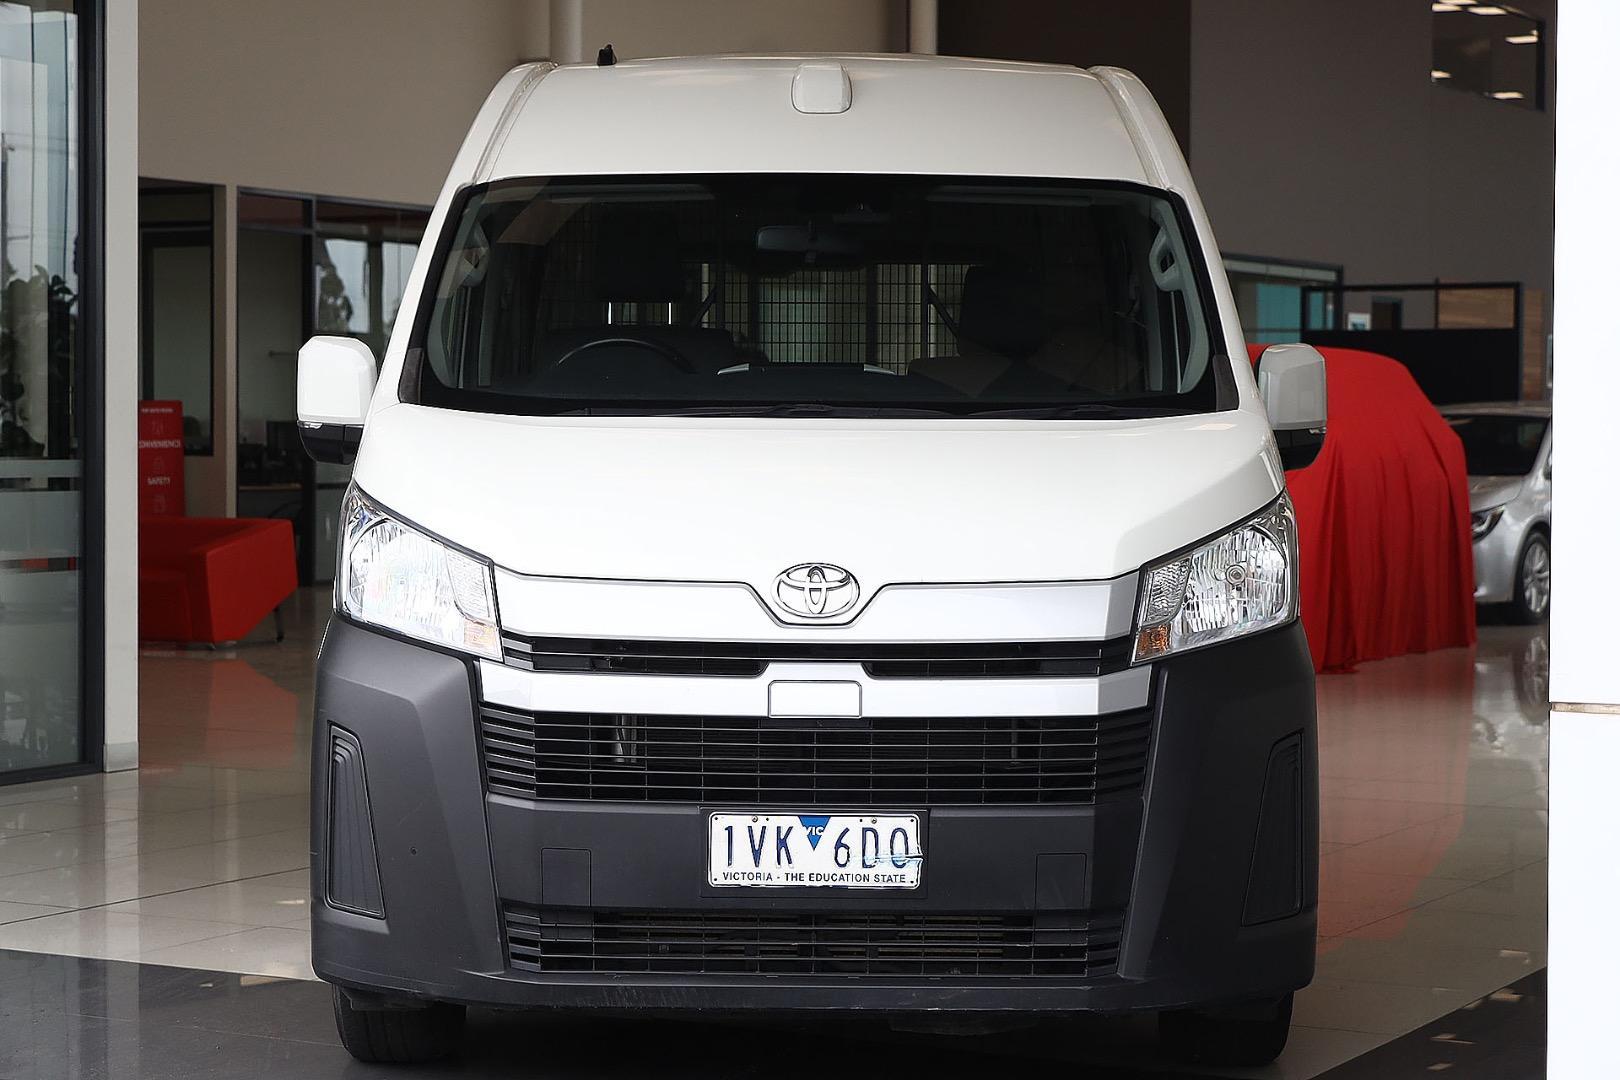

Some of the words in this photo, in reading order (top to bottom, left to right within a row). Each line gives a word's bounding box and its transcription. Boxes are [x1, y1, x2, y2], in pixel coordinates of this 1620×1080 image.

[801, 826, 825, 836] VIC
[725, 825, 793, 867] 1VK
[722, 871, 773, 882] VICTORIA
[785, 872, 805, 882] THE
[808, 872, 870, 883] EDUCATION
[873, 873, 906, 883] STATE
